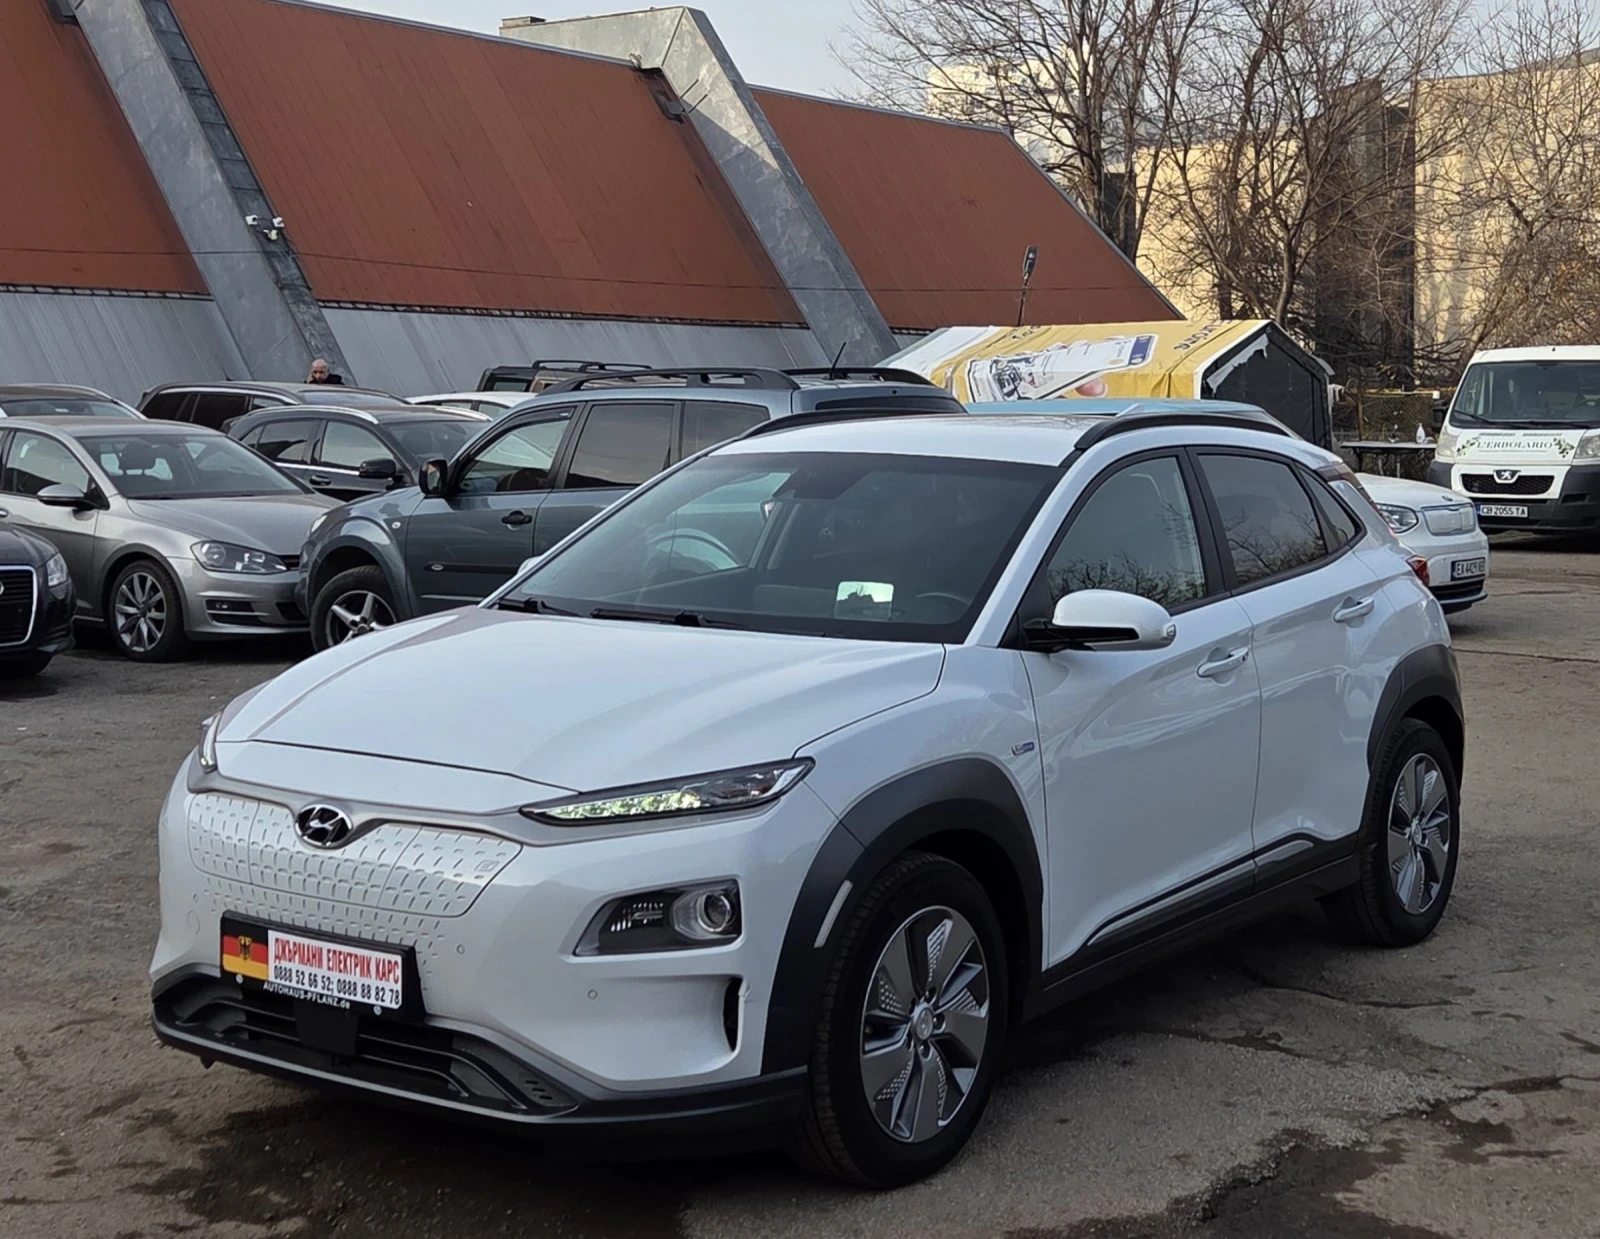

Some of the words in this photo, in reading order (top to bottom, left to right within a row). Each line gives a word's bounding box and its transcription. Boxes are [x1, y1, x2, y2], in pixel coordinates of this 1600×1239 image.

[1477, 441, 1553, 449] L'ERBOLARIO
[1515, 507, 1526, 516] TA
[274, 938, 323, 970] ДЖЪРМАНИ
[327, 949, 372, 979] ЕЛЕКТРИК
[375, 958, 399, 984] КАРС
[263, 981, 351, 1010] AUTOHAUS-PFLANZ.de
[274, 965, 293, 980] 0888
[296, 969, 306, 984] 52
[308, 972, 318, 988] 66
[321, 975, 334, 994] 52;
[337, 978, 358, 997] 0888
[361, 982, 372, 1000] 88
[375, 985, 386, 1003] 82
[389, 988, 400, 1006] 78
